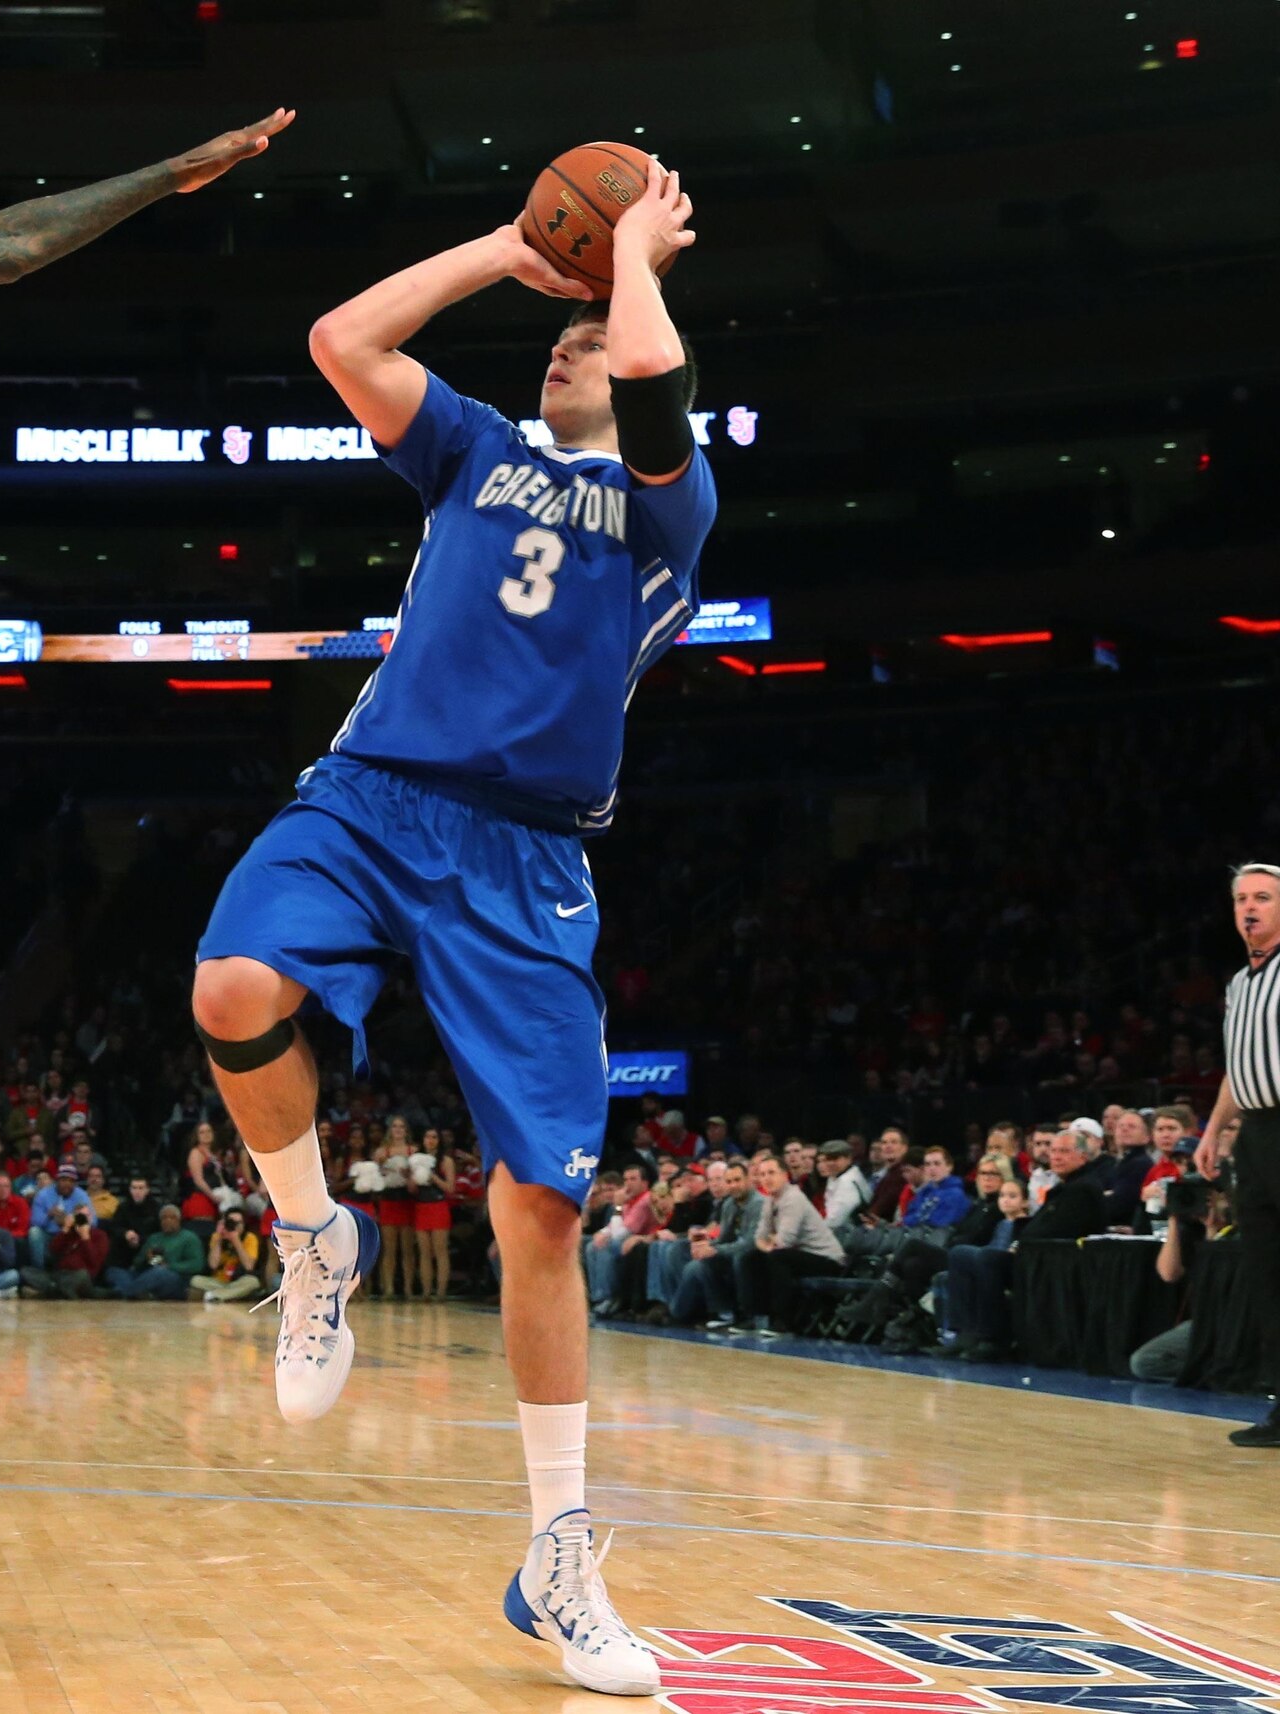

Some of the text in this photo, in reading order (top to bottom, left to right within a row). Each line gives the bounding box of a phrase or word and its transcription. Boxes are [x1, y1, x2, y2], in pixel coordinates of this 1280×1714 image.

[16, 428, 205, 462] MUSCLE MILK
[475, 463, 627, 544] CREIGTON
[498, 526, 565, 619] 3
[120, 621, 161, 635] FOULS
[185, 620, 250, 634] TIMEOUTS
[131, 638, 149, 658] 0
